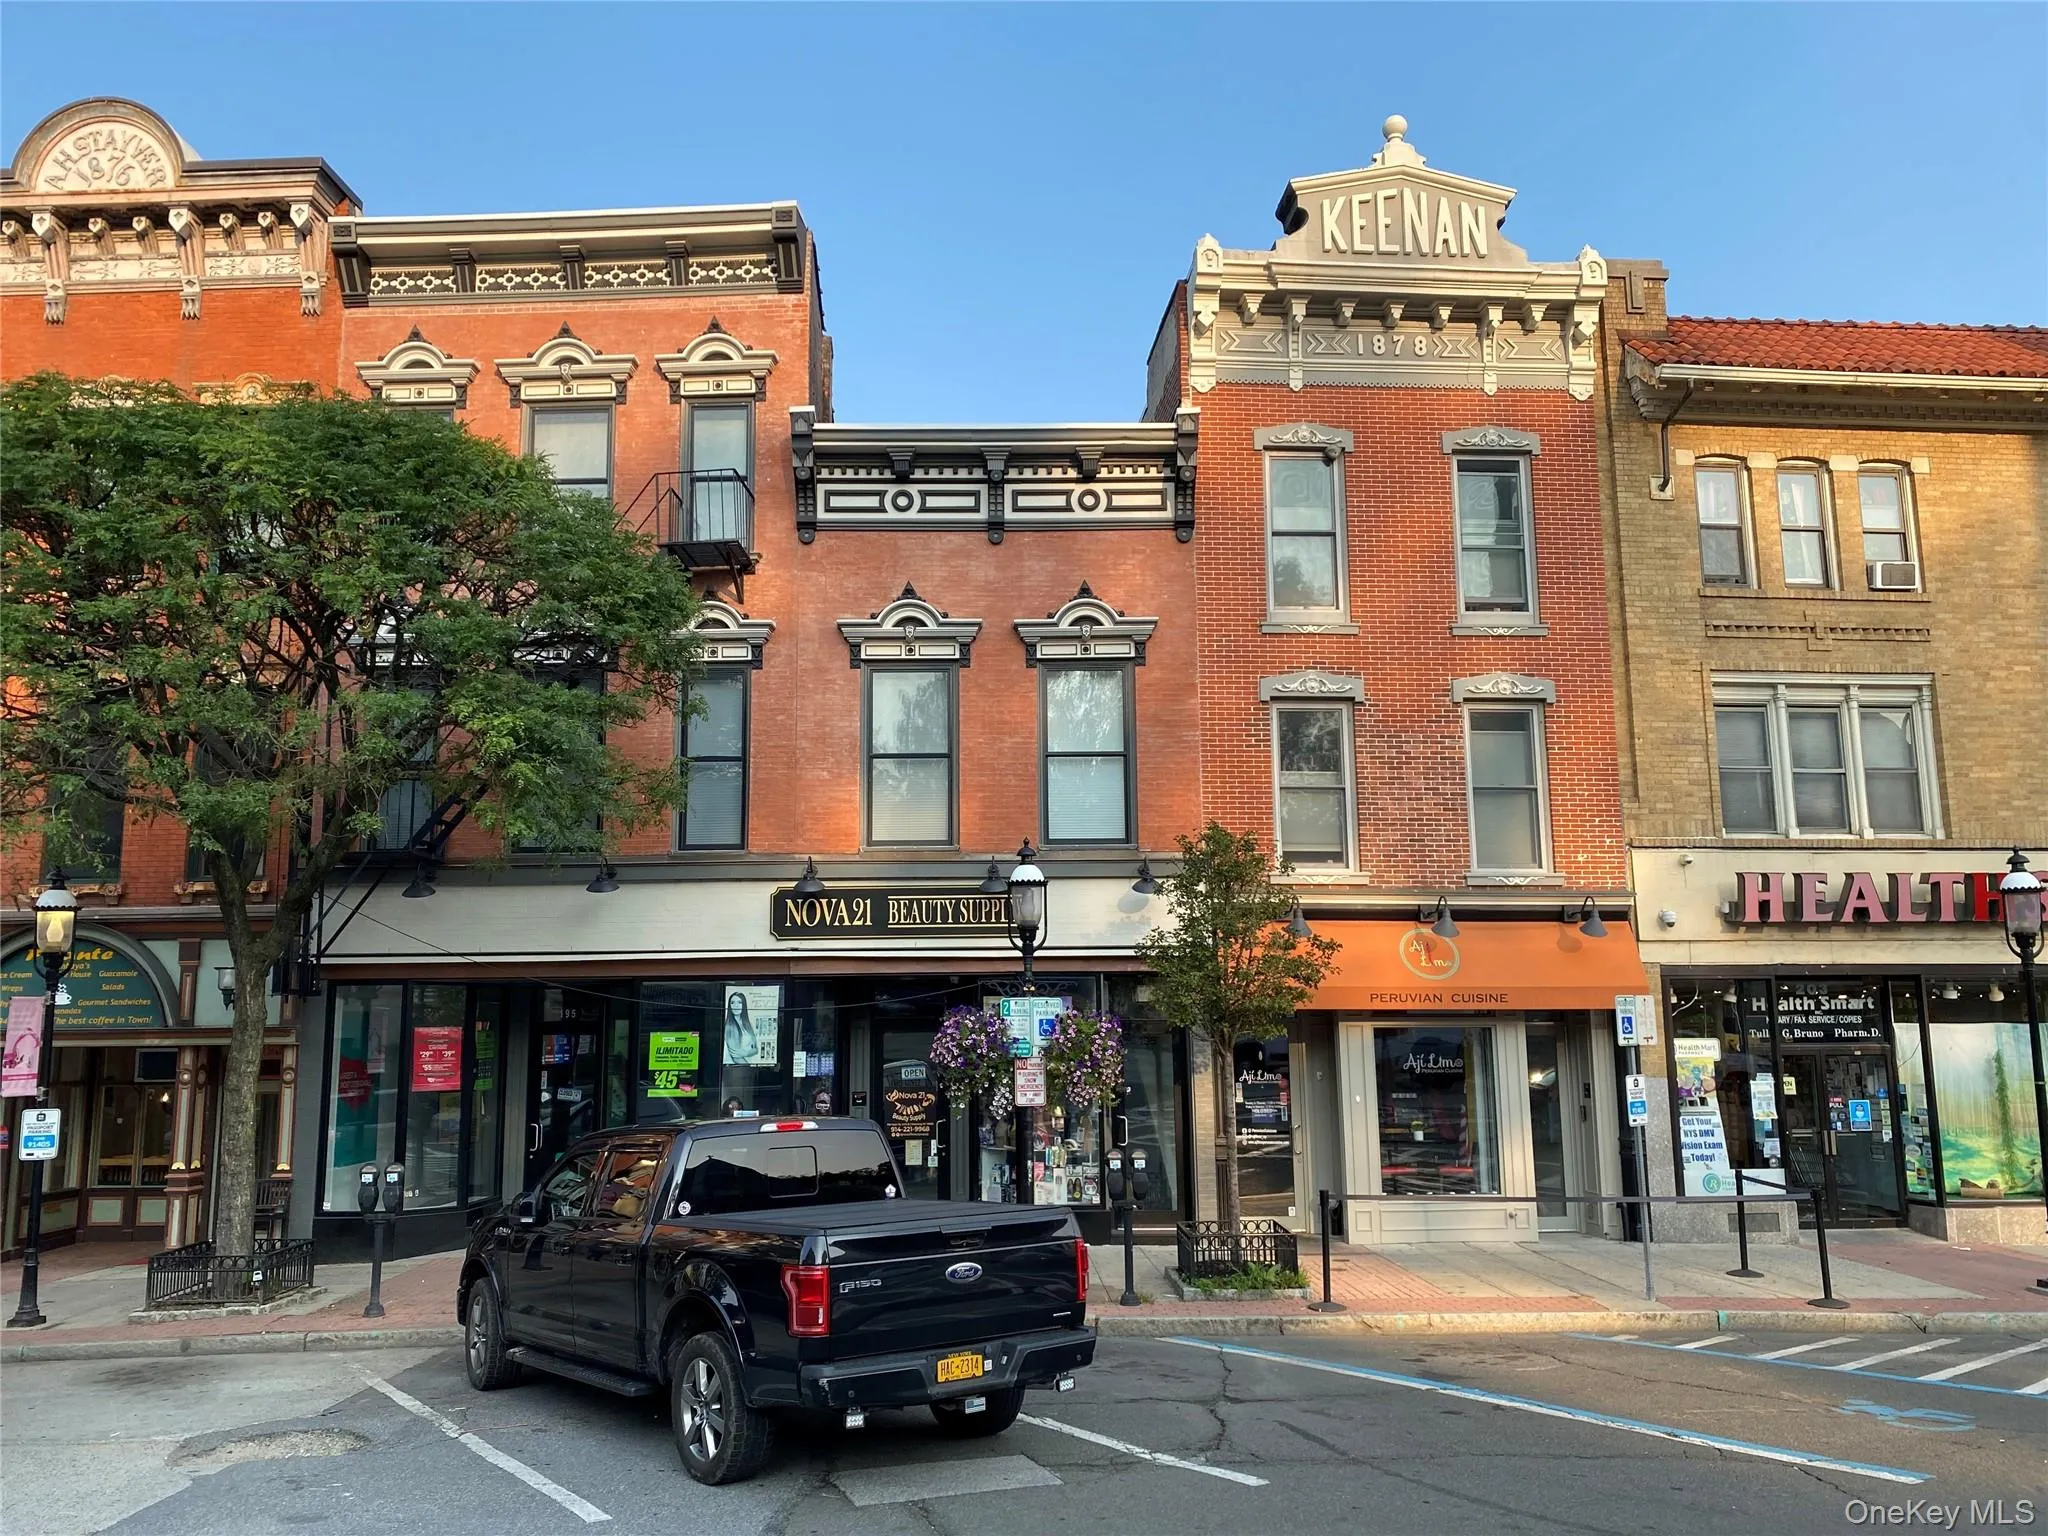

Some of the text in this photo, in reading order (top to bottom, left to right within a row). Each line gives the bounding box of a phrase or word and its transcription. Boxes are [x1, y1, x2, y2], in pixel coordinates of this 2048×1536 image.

[1321, 187, 1488, 258] KEENAN
[1356, 333, 1428, 356] 1878
[887, 900, 955, 924] BEAUTY
[25, 948, 114, 960] Pante
[1370, 993, 1509, 1003] PERUVIAN CUISINE
[1752, 996, 1874, 1011] Halth Smart
[1003, 1002, 1009, 1014] 2
[656, 1046, 694, 1055] ILIMITADO
[1017, 1060, 1027, 1069] NO
[904, 1068, 925, 1078] OPEN
[654, 1071, 679, 1088] $45
[1681, 1118, 1712, 1126] Get Your
[1699, 1129, 1715, 1138] DMV
[1704, 1141, 1723, 1150] Exam
[1690, 1153, 1716, 1162] Today!
[954, 1265, 975, 1279] Ford
